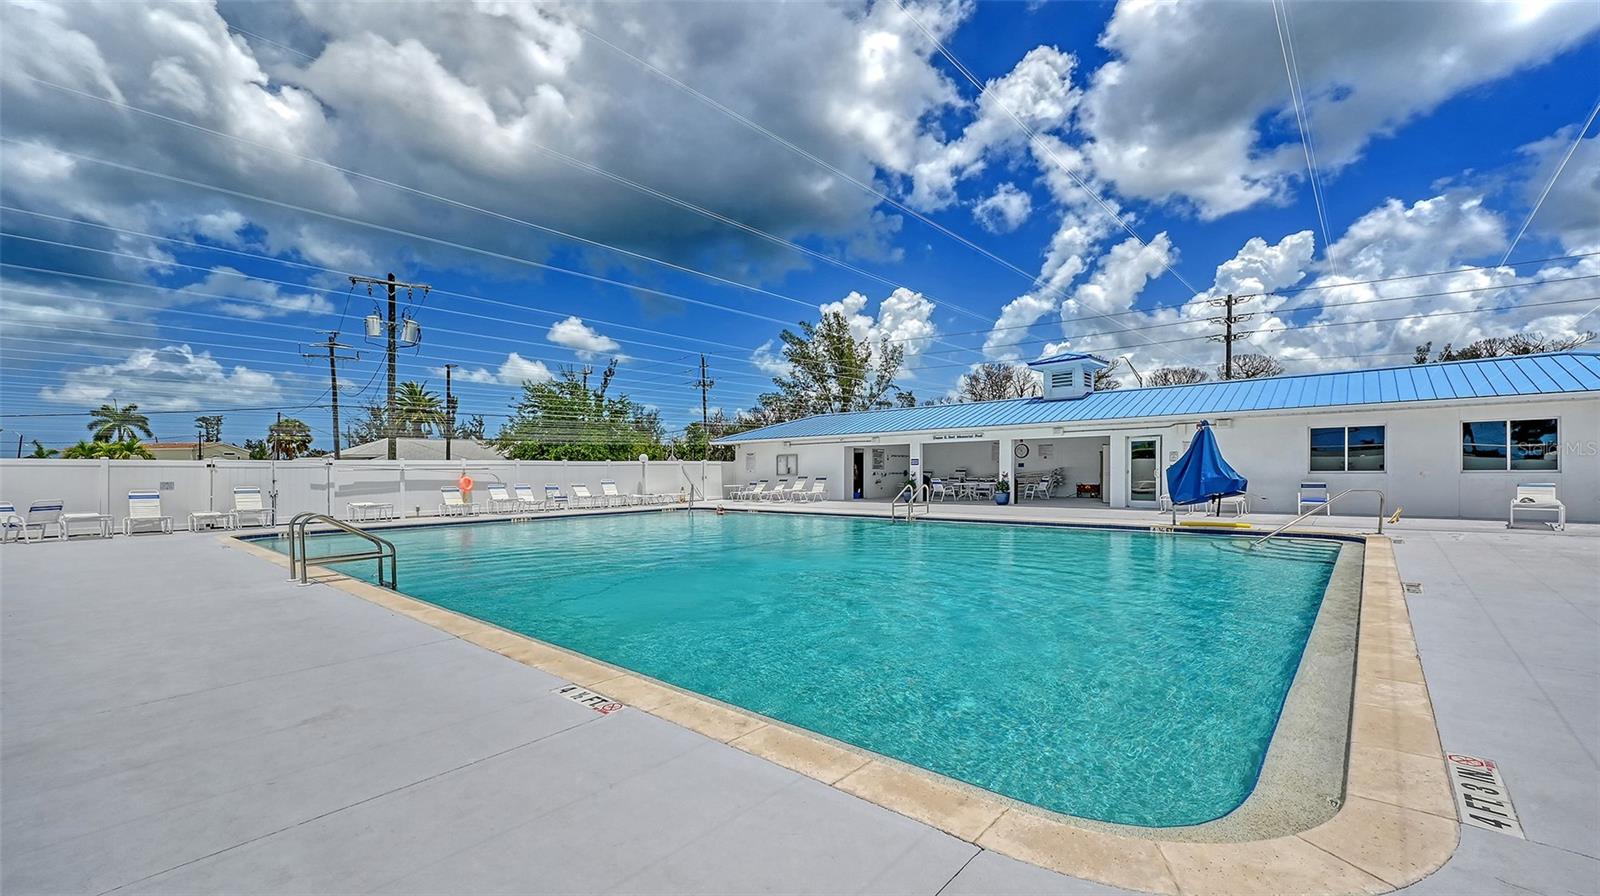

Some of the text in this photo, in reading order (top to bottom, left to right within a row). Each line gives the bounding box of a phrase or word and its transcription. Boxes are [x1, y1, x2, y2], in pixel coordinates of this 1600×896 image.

[581, 696, 608, 707] FT
[1456, 766, 1512, 829] 4 FT 3 IN
